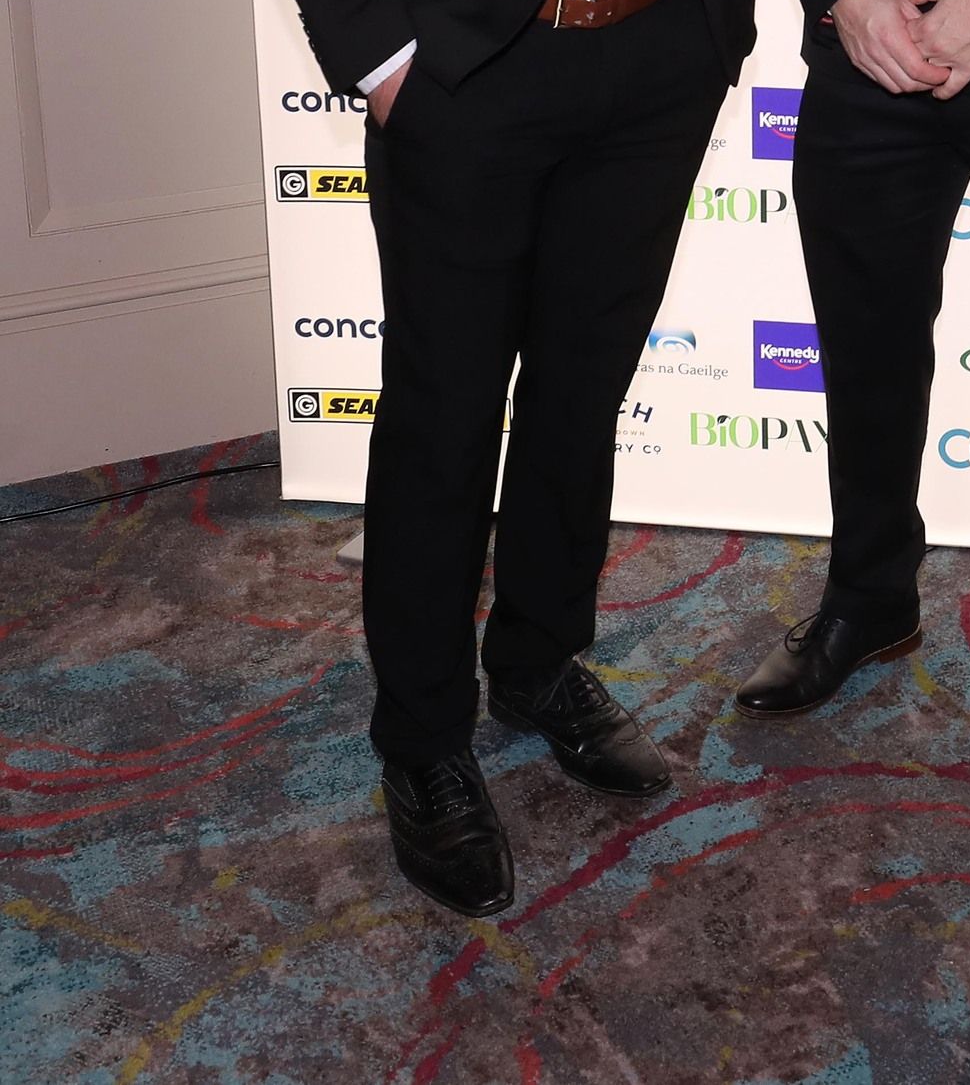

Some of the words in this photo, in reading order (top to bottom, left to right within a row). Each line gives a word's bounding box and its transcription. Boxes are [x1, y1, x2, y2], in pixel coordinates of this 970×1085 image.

[760, 343, 820, 364] Kennedy
[779, 357, 802, 365] CENTRE
[658, 364, 674, 374] na
[678, 362, 729, 381] Gaeilge
